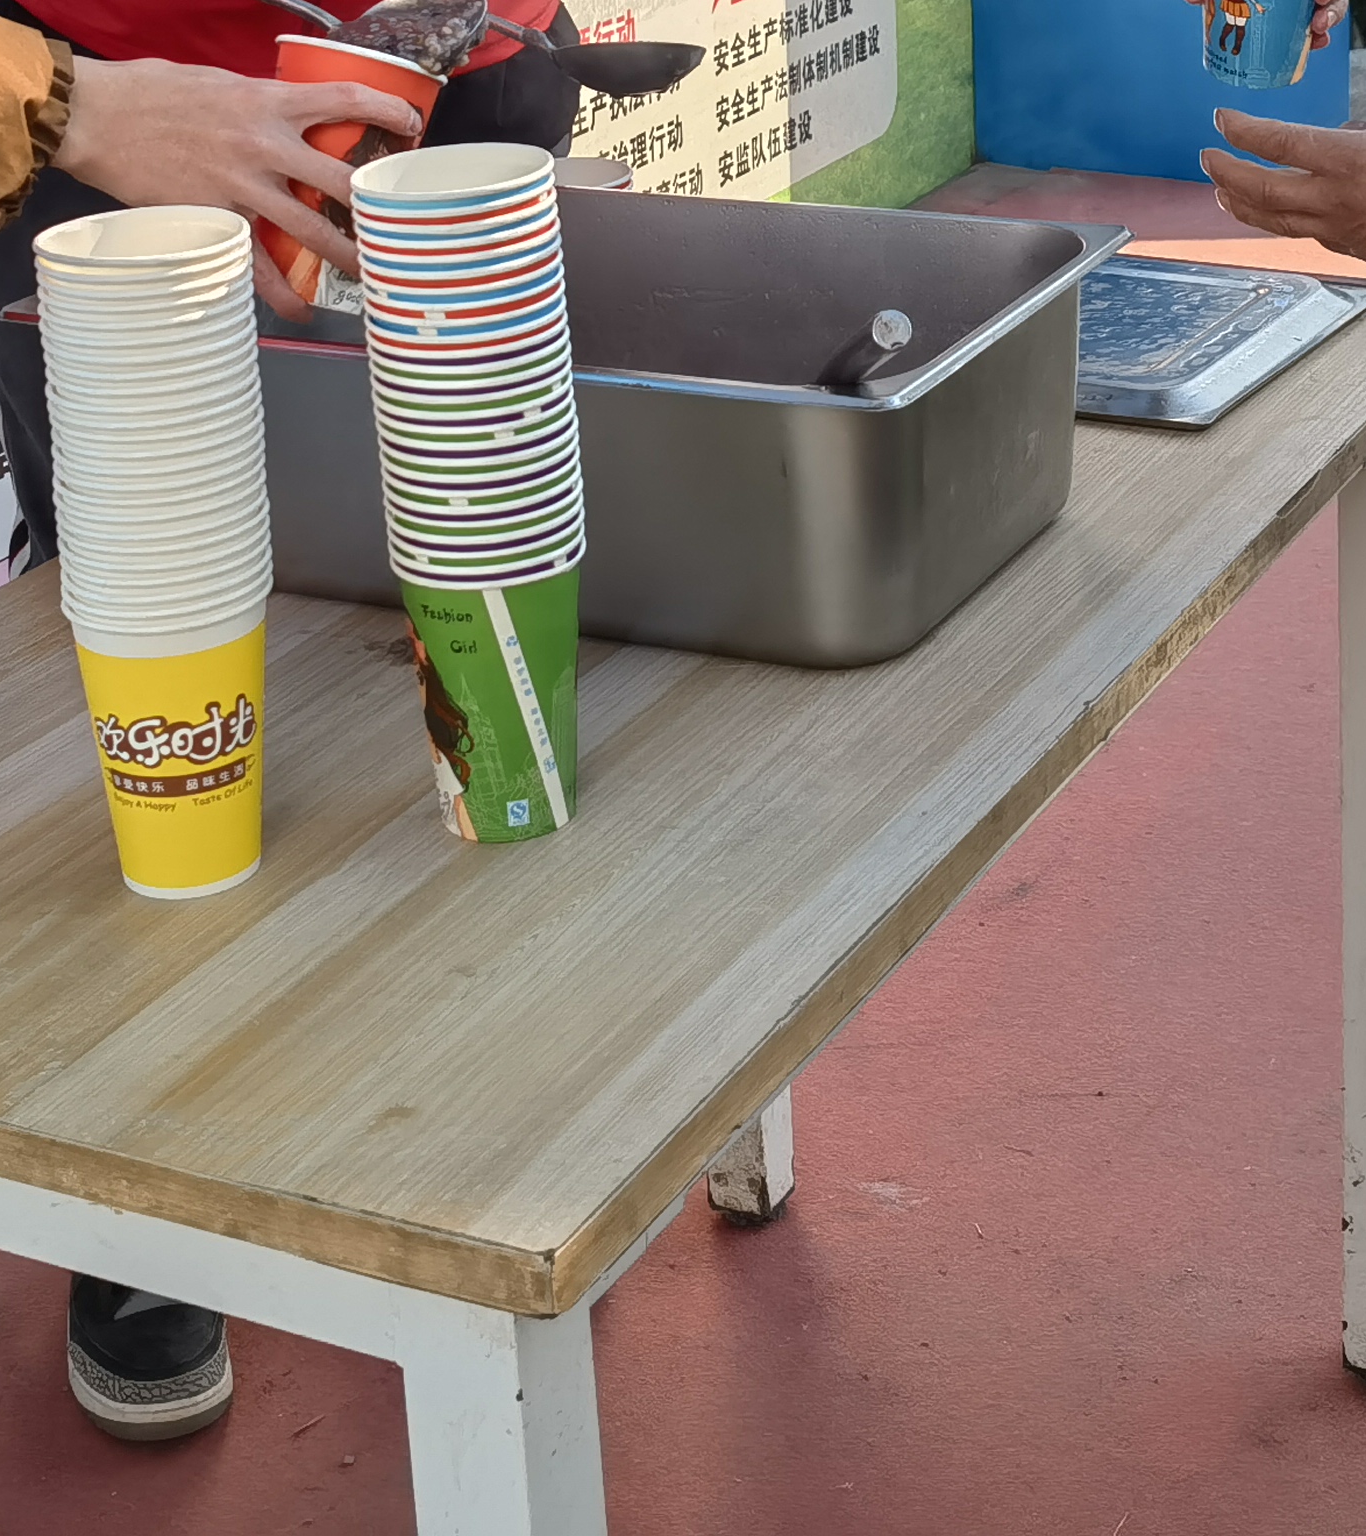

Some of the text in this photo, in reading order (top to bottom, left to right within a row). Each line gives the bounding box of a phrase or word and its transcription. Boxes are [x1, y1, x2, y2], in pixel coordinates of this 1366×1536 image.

[715, 24, 881, 133] 安全生产法制体制机制建设
[599, 114, 684, 170] 治理行动
[718, 109, 813, 188] 安监队伍建设
[421, 604, 473, 624] Fashion
[450, 639, 477, 654] Girl
[95, 695, 257, 768] 欢乐时光
